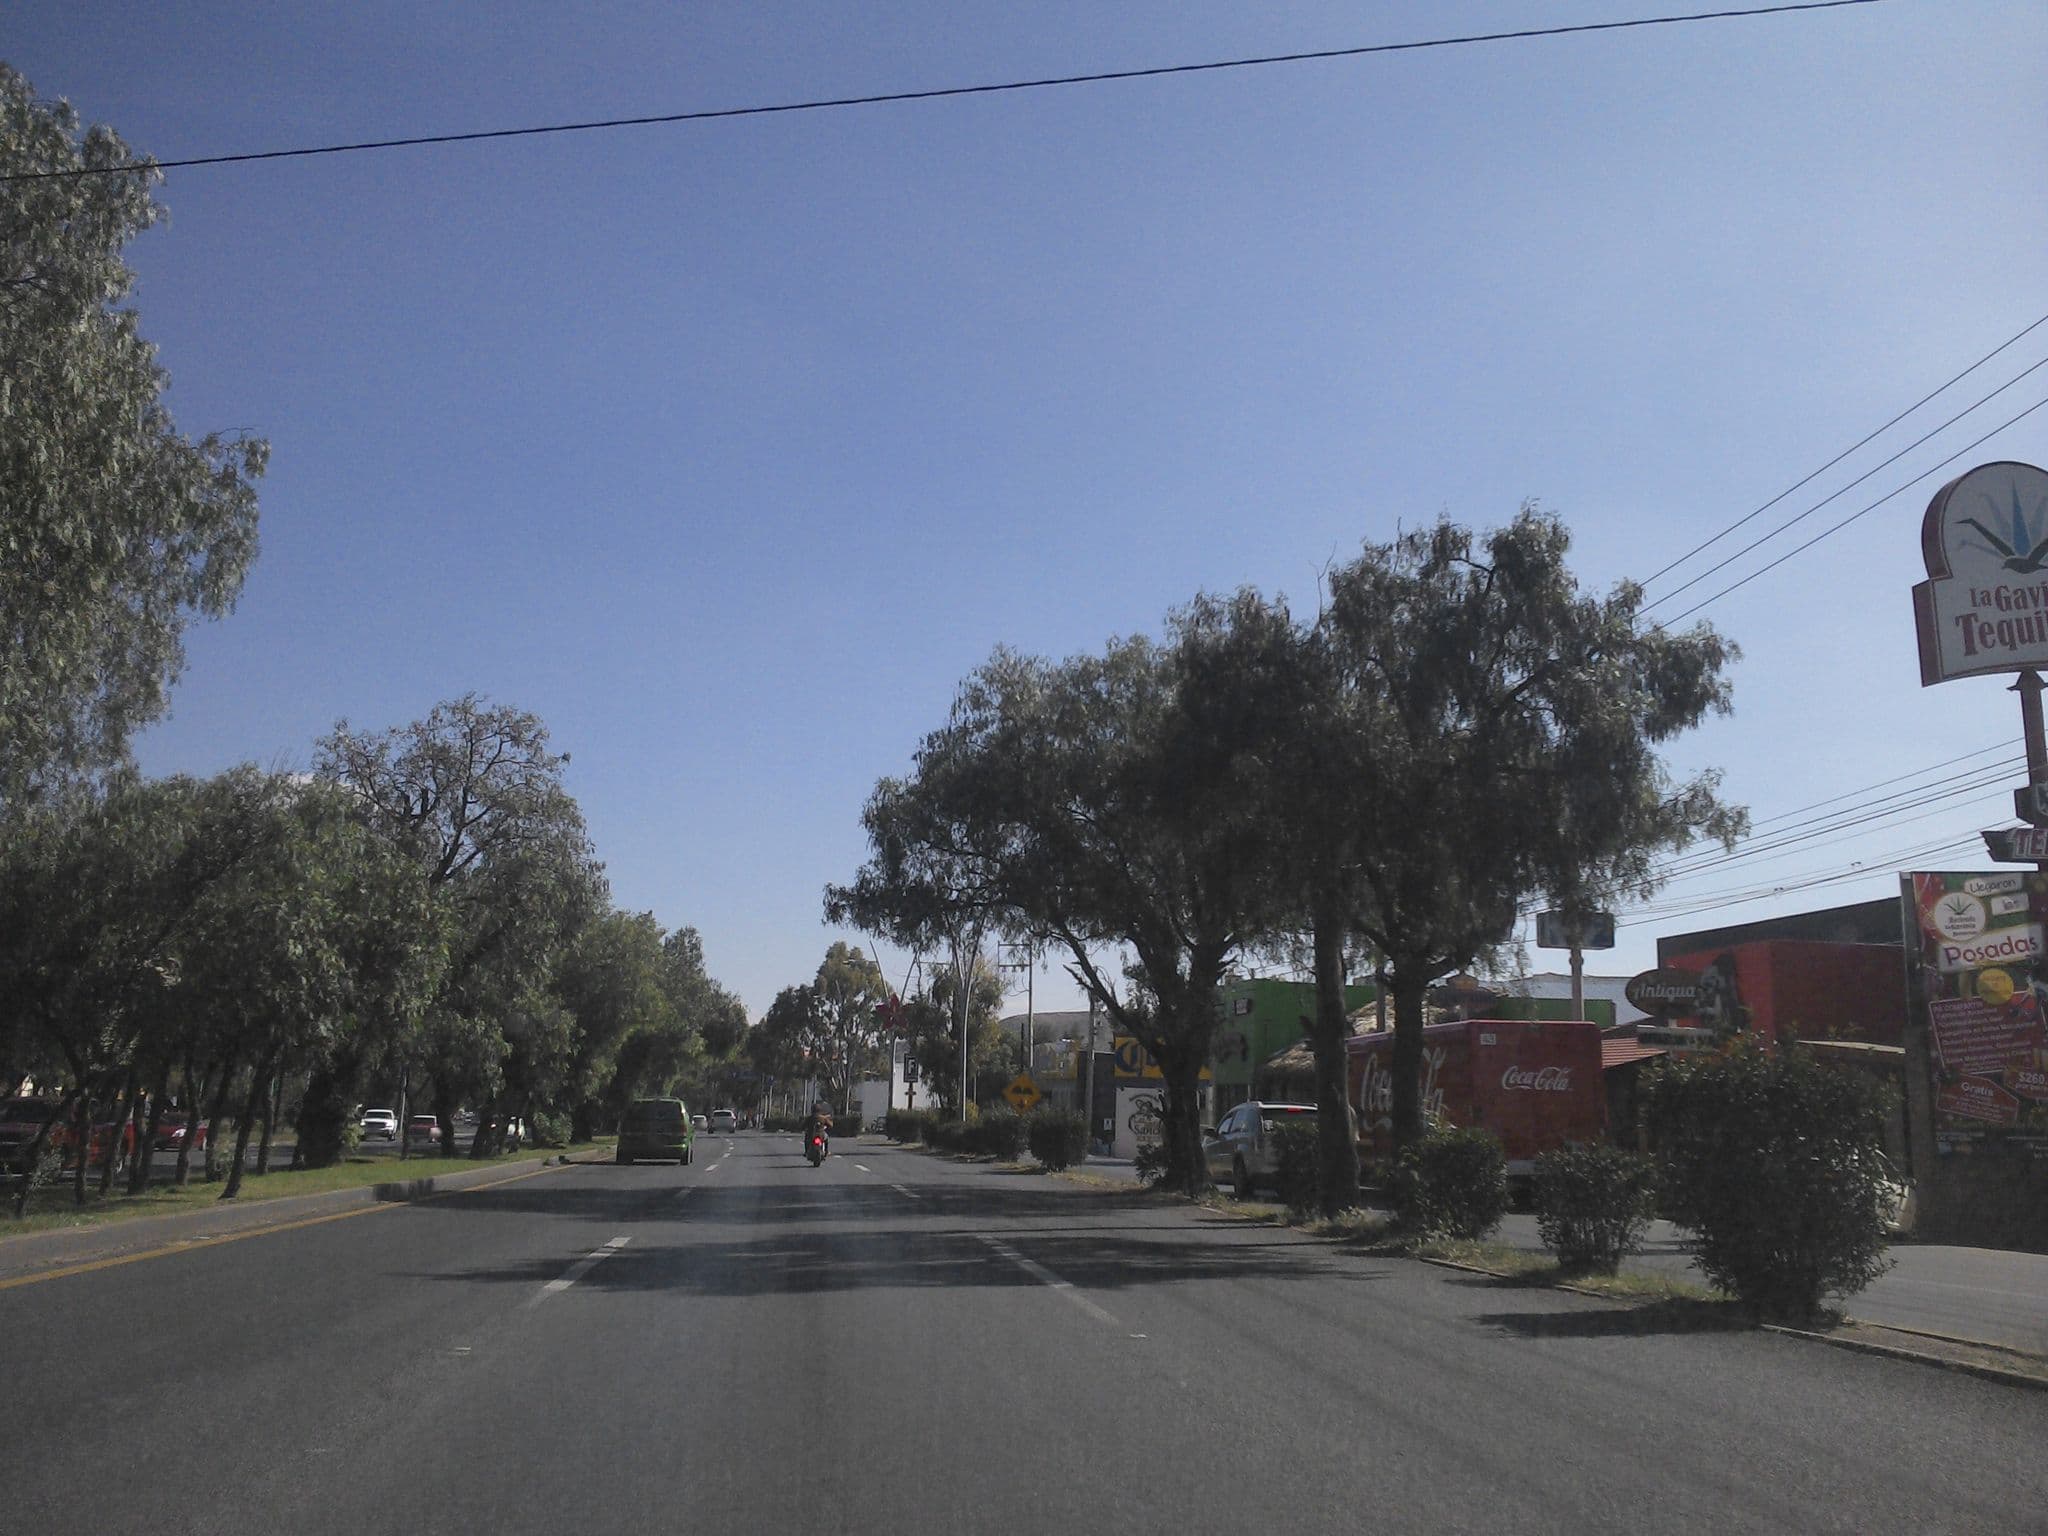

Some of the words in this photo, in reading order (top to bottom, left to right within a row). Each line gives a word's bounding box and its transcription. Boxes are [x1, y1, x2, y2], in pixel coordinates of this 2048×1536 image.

[1954, 610, 2048, 656] Tequi
[1943, 935, 2038, 966] Posadas
[1634, 983, 1697, 1001] Antigua
